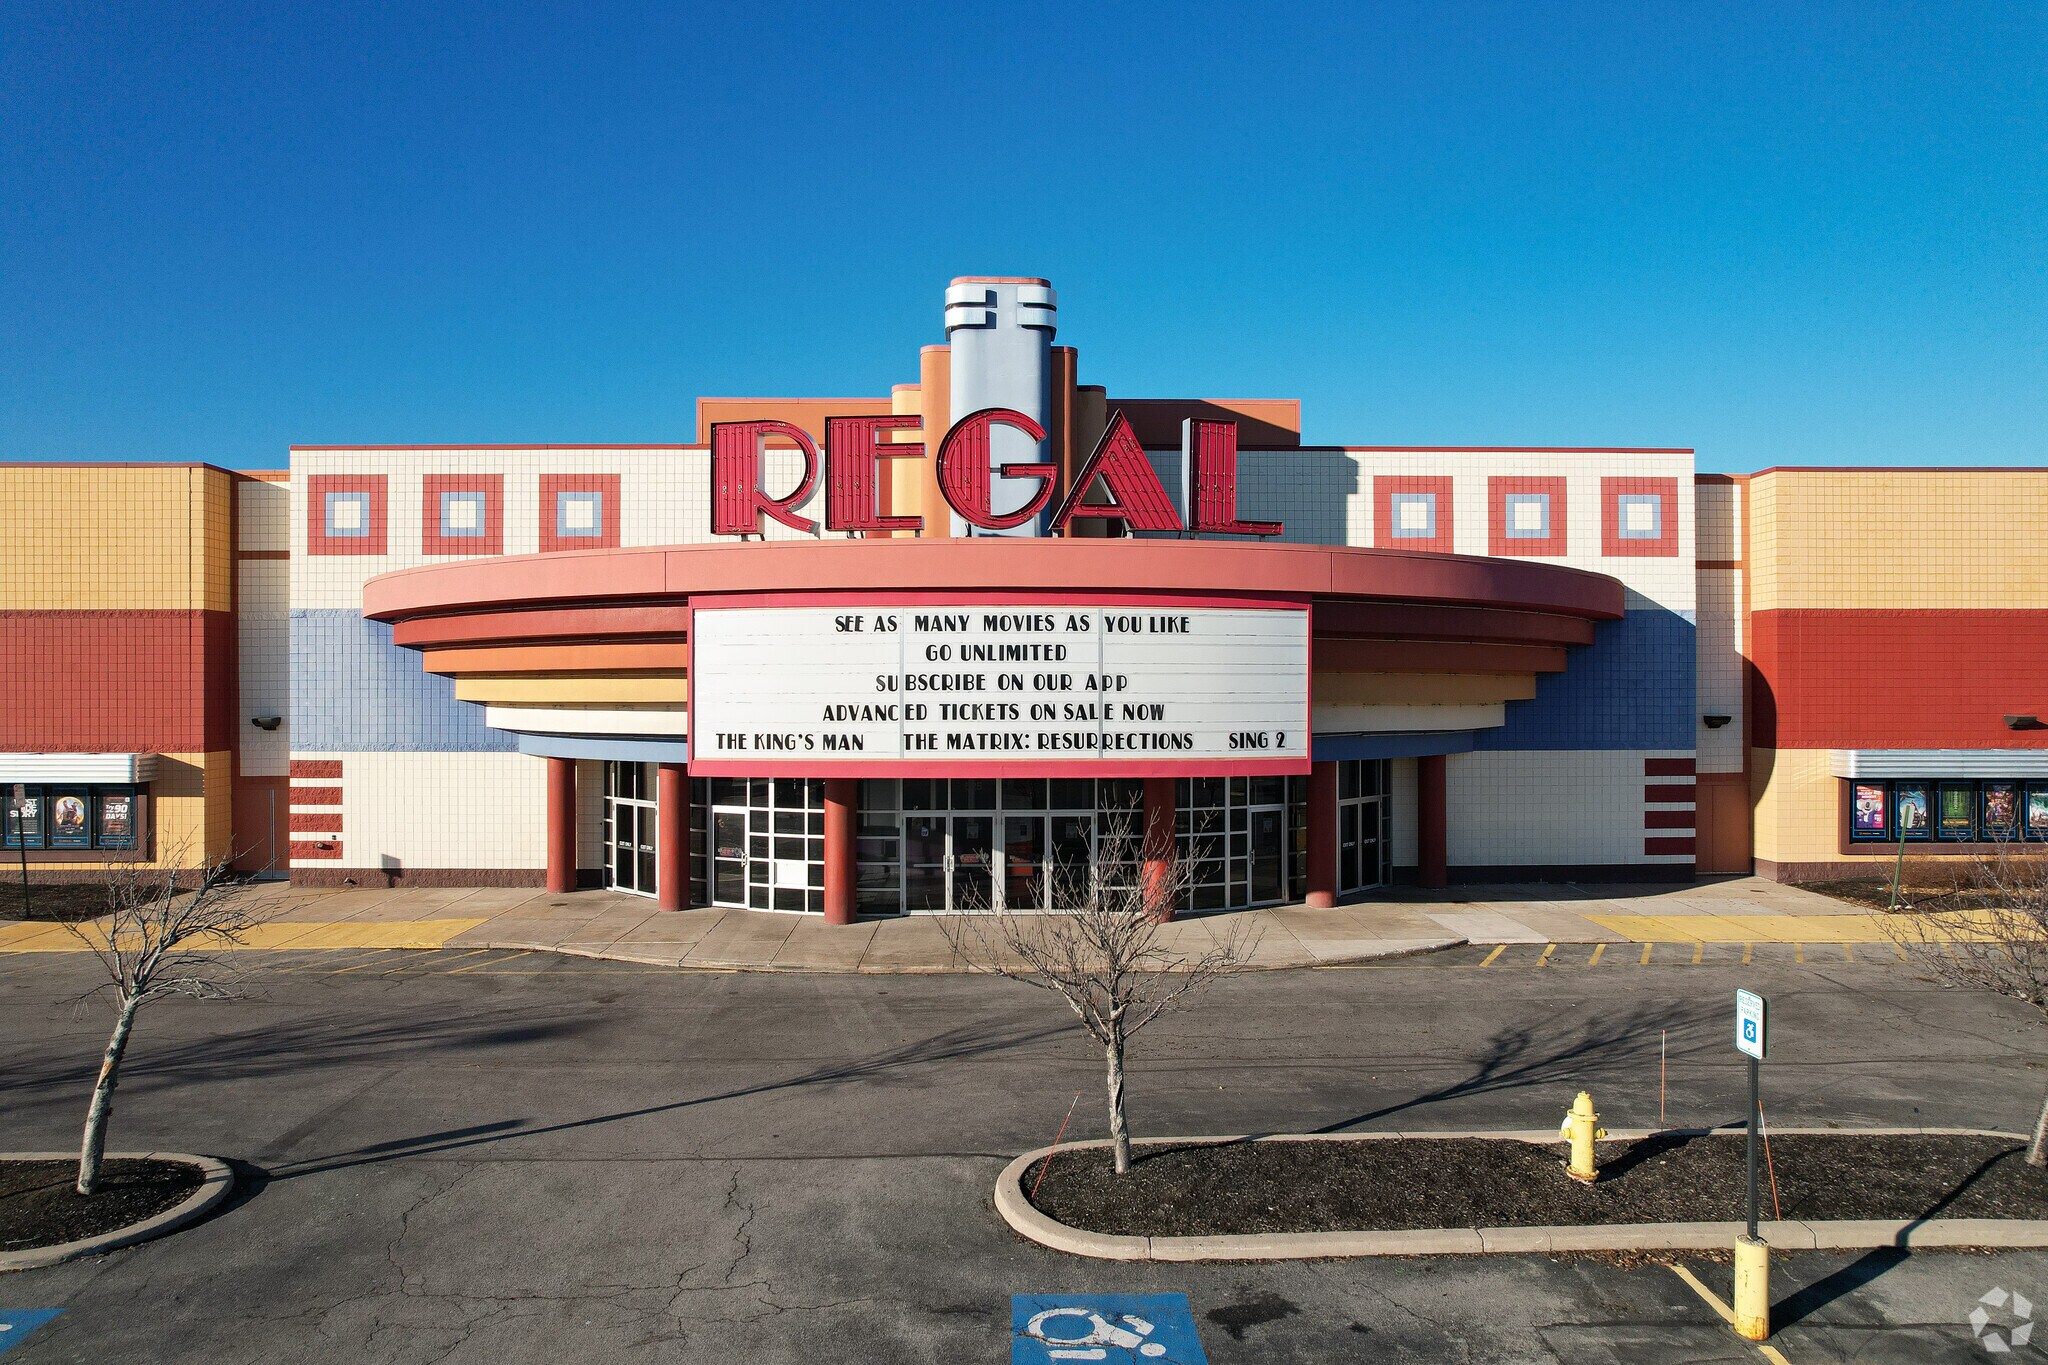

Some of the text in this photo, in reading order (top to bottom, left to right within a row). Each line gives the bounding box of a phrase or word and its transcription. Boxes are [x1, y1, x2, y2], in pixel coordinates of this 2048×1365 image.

[710, 407, 1284, 536] REGAL
[835, 614, 1190, 633] SEE AS MANY MOVIES AS YOU LIKE
[925, 644, 1068, 662] GO UNLIMITED
[876, 674, 1128, 692] SUBSCRIBE ON OUR APP
[823, 703, 1165, 722] ADVANCED TICKETS ON SALE NOW
[715, 733, 864, 751] THE KING'S MAN
[904, 733, 1194, 751] THE MATRIX: RESURRECTIONS
[1228, 731, 1286, 749] SING 2
